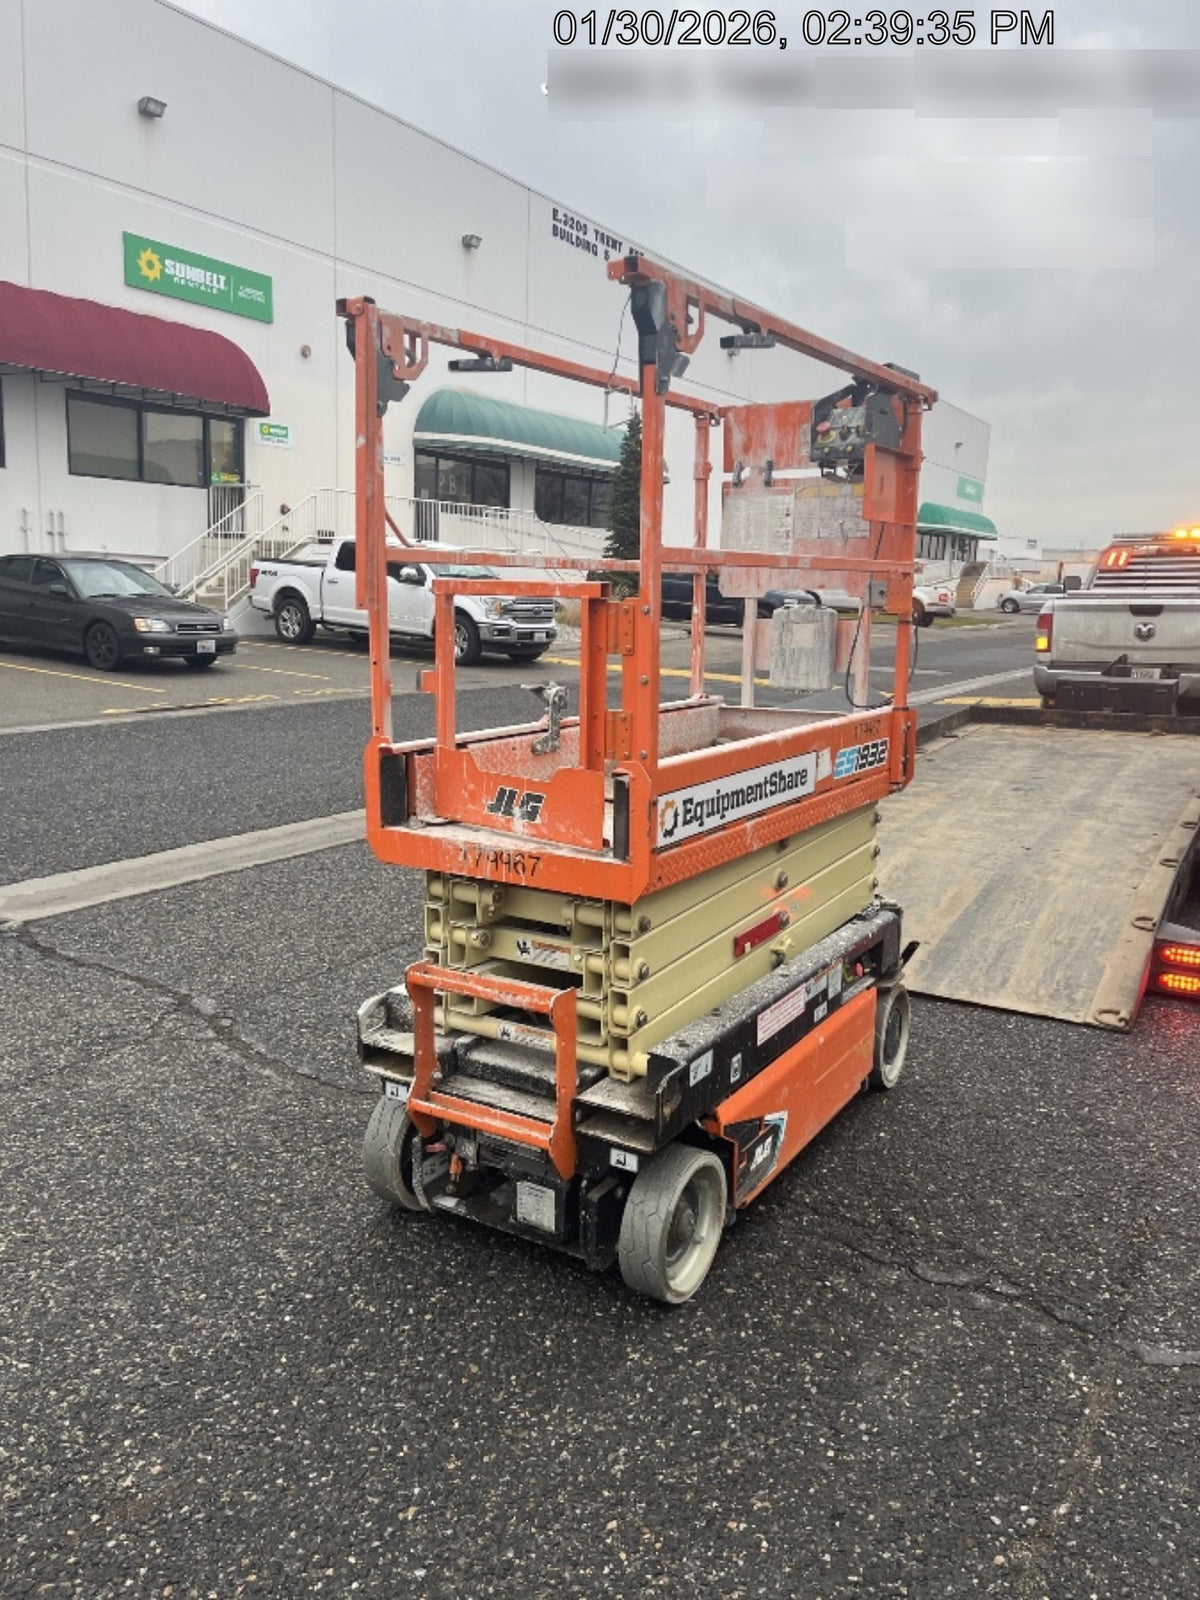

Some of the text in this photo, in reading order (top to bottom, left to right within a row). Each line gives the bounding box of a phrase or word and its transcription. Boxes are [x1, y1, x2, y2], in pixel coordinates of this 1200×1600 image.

[552, 223, 598, 256] BUILDING
[594, 229, 622, 253] TRENT
[164, 258, 227, 291] SUNBELT
[835, 739, 889, 778] ES1932
[485, 785, 546, 823] JLG
[681, 766, 808, 827] EquipmentShare
